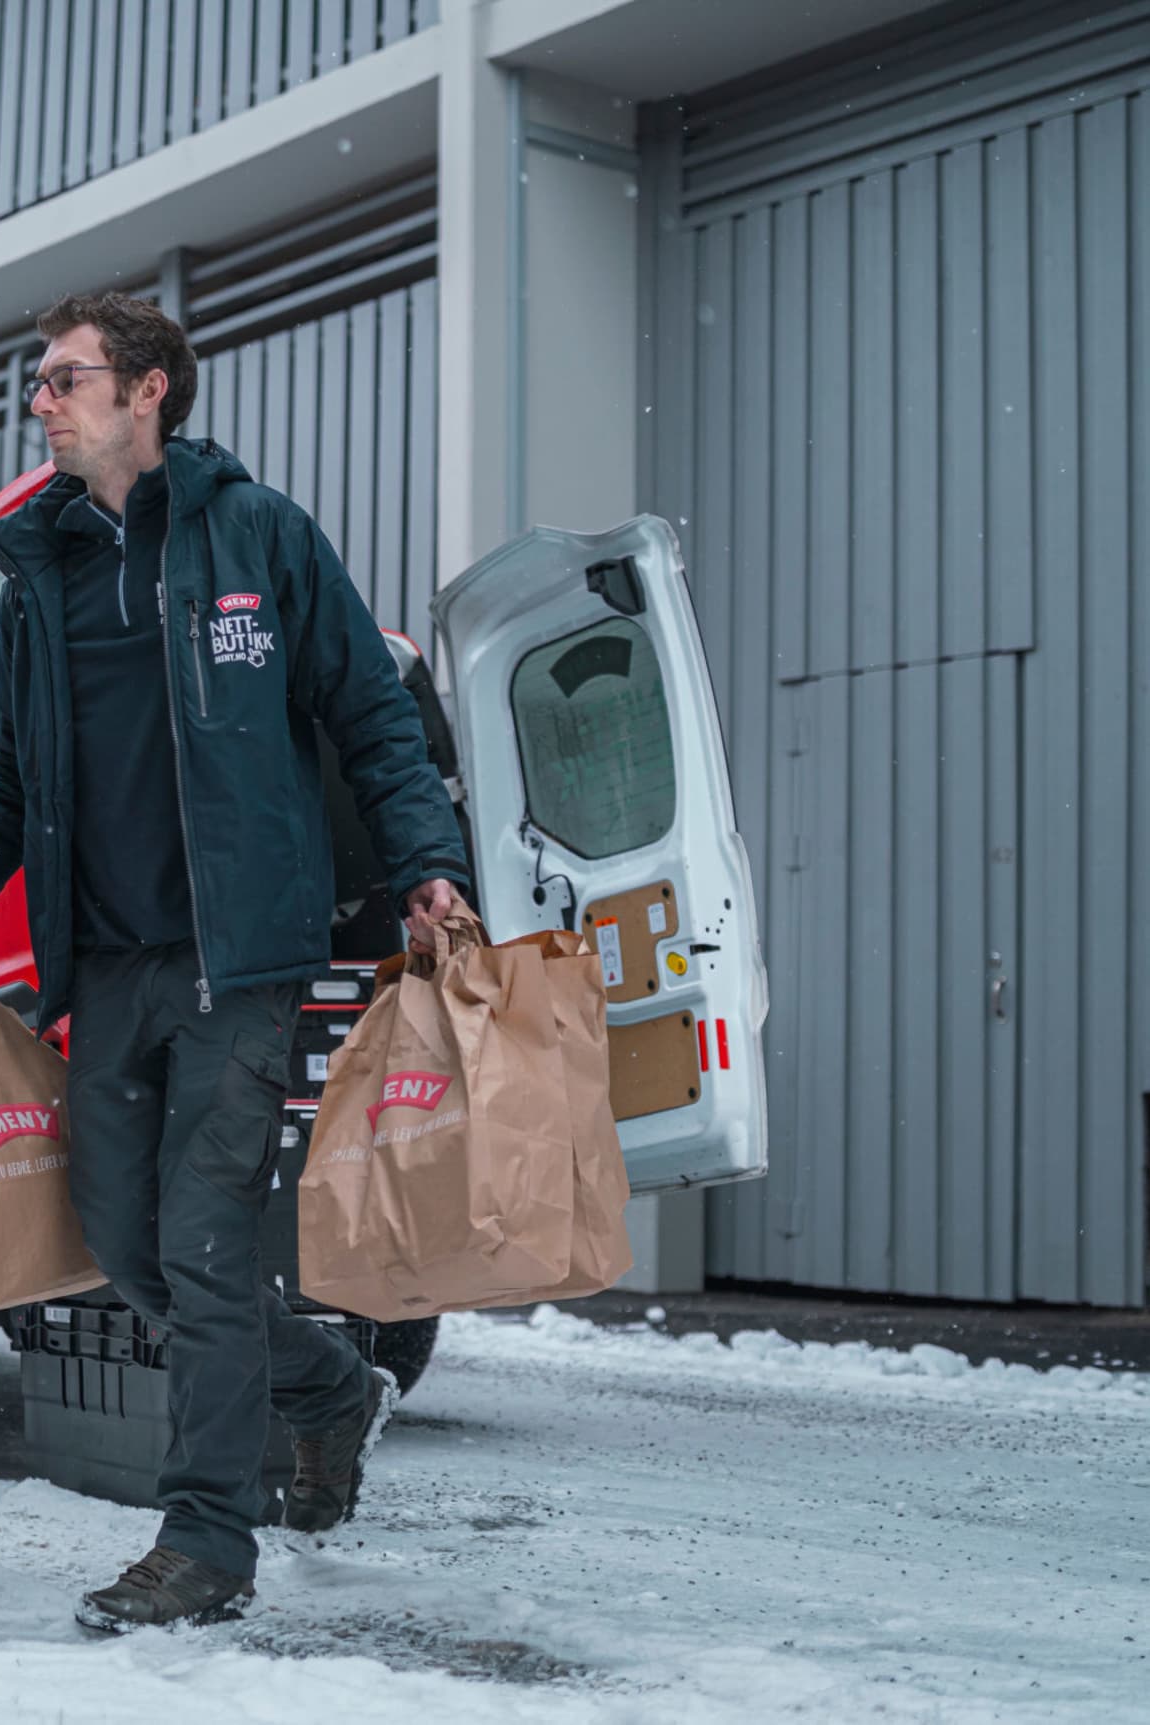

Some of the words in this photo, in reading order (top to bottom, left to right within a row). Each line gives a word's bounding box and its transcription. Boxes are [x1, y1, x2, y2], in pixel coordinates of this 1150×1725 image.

[222, 597, 257, 609] MENY
[210, 615, 259, 637] NETT-
[214, 652, 247, 664] MENY.NO
[382, 1079, 443, 1101] ENY
